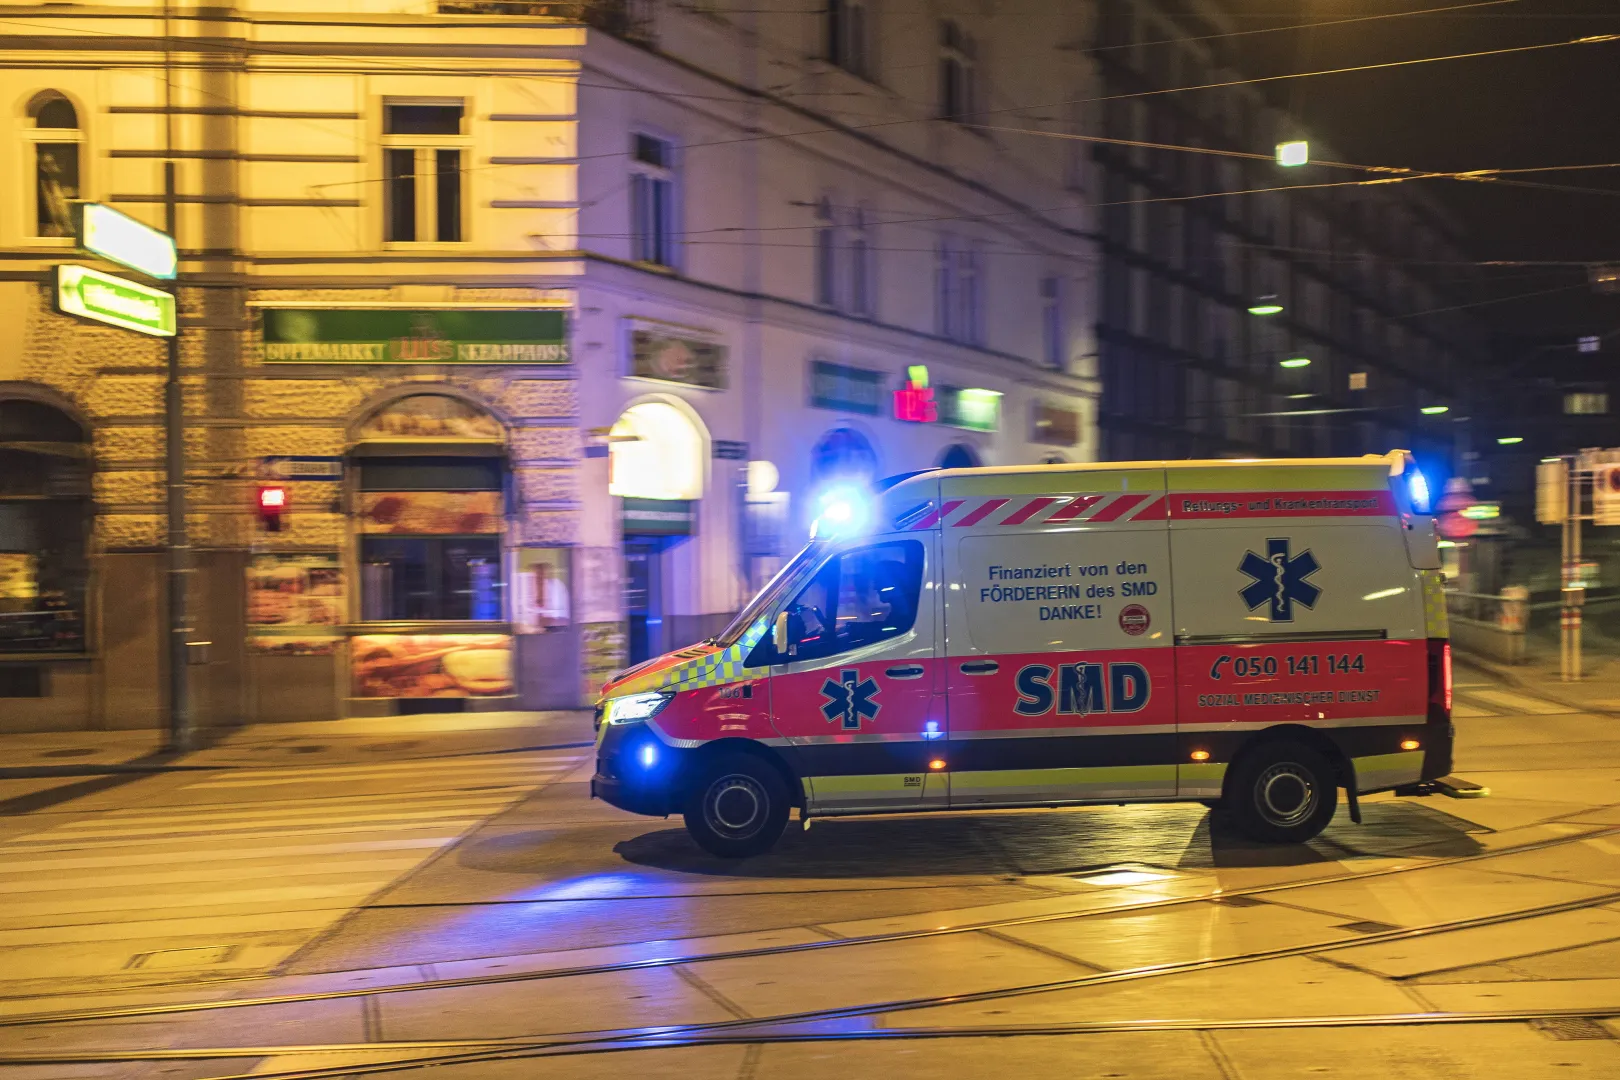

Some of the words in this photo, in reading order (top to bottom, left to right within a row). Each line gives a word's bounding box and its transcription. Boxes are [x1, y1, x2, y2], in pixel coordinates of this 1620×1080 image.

[1182, 499, 1243, 514] Rettungs-
[1247, 498, 1270, 511] und
[1274, 496, 1379, 513] Krankentransport
[988, 563, 1071, 580] Finanziert
[1079, 564, 1108, 577] von
[1116, 561, 1147, 575] den
[980, 584, 1080, 603] FÖRDERERN
[1086, 584, 1115, 599] des
[1121, 581, 1157, 597] SMD
[1039, 604, 1102, 621] DANKE!
[1234, 656, 1278, 677] 050
[1286, 655, 1319, 675] 141
[1327, 653, 1365, 674] 144
[1013, 661, 1152, 717] SMD
[1198, 693, 1240, 708] SOZIAL
[1243, 691, 1334, 706] MEDIZINISCHER
[1337, 690, 1380, 703] DIENST
